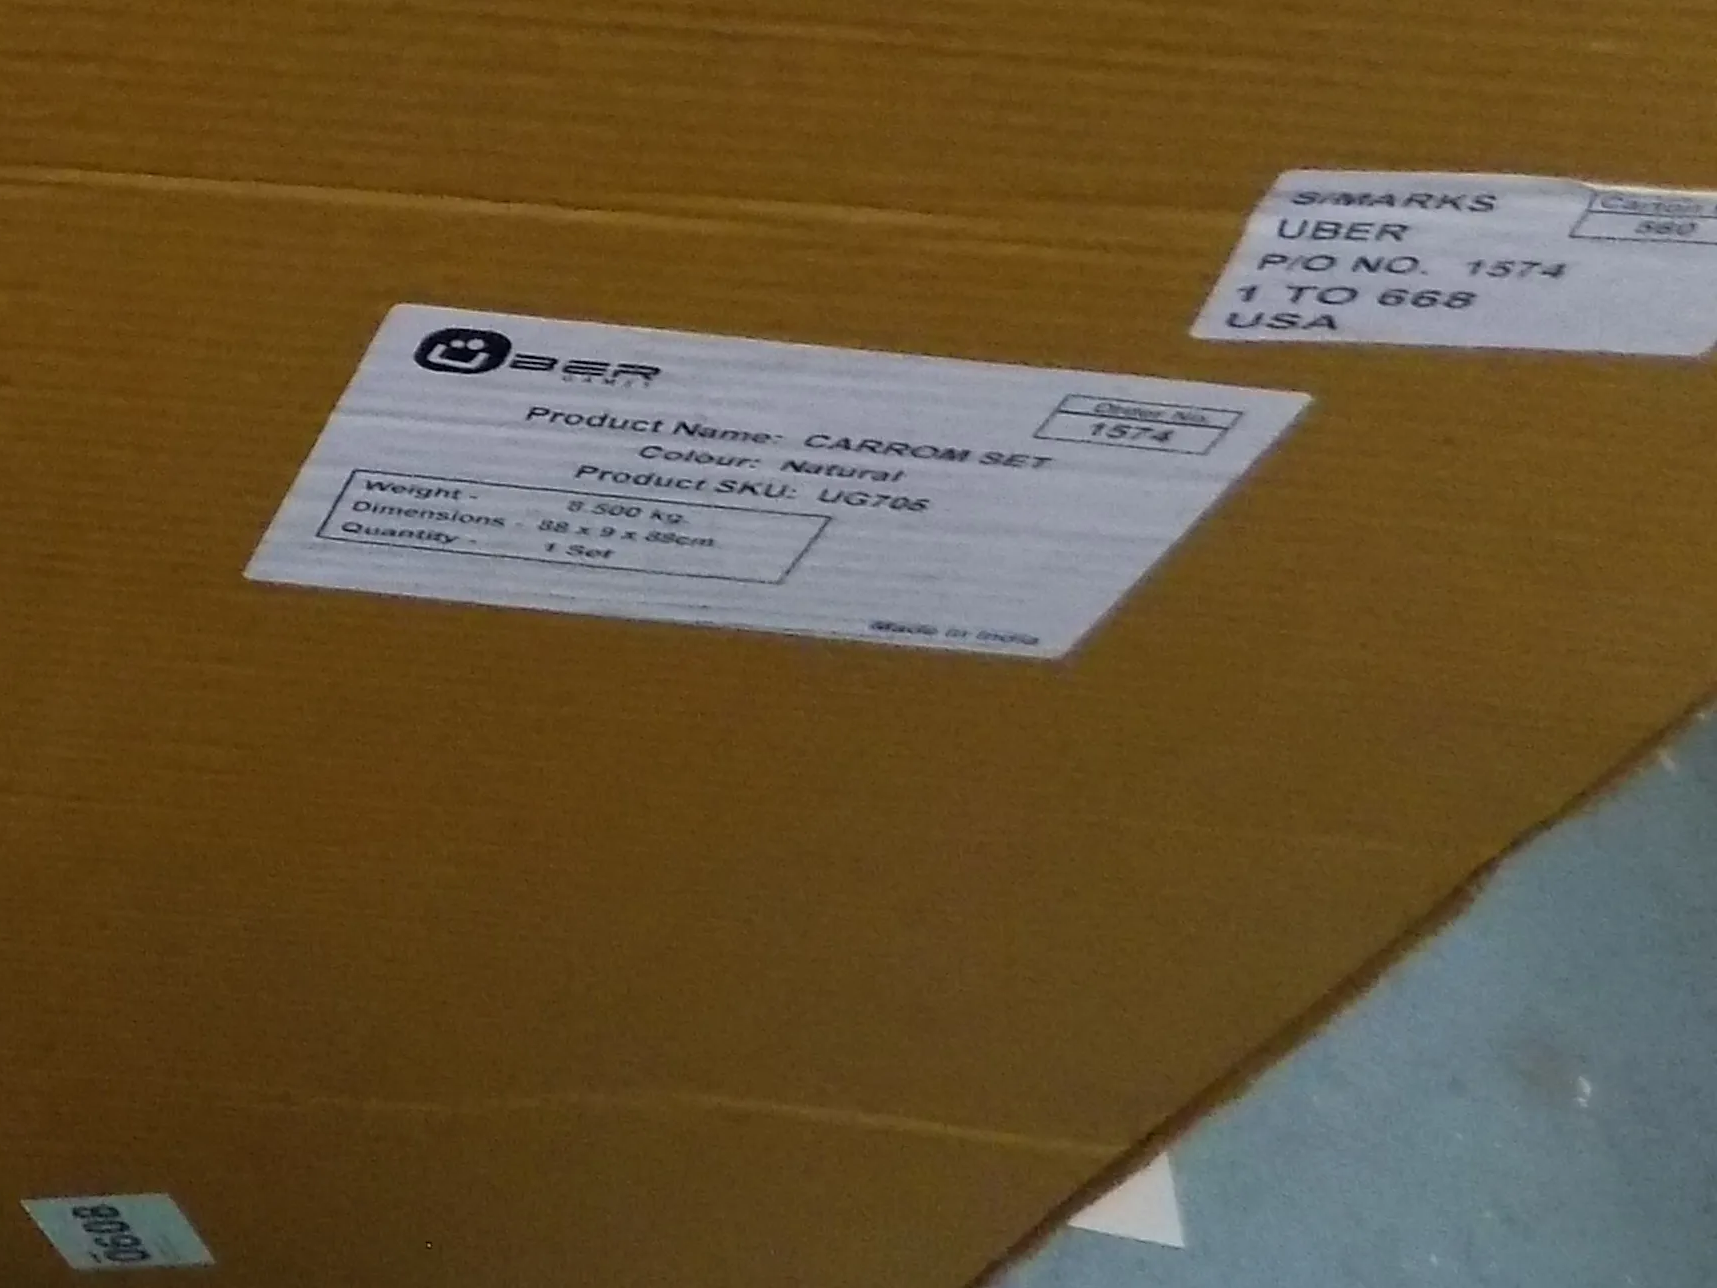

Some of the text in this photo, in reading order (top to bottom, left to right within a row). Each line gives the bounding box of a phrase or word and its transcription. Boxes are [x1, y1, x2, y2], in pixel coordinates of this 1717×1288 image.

[1290, 190, 1498, 213] S/MARKS
[1276, 217, 1412, 243] UBER
[1256, 253, 1568, 280] P/O NO. 1574
[1236, 284, 1480, 310] 1 TO 668
[1224, 311, 1340, 332] USA
[524, 405, 1055, 471] Product Name: CARROM SET
[1089, 421, 1176, 443] 1574
[638, 444, 906, 484] Colour: Natural
[363, 478, 463, 503] Weight
[574, 463, 707, 493] Product
[714, 479, 798, 501] SKU:
[350, 500, 506, 529] Dimensions
[340, 520, 462, 548] Quantity
[564, 543, 616, 560] Set
